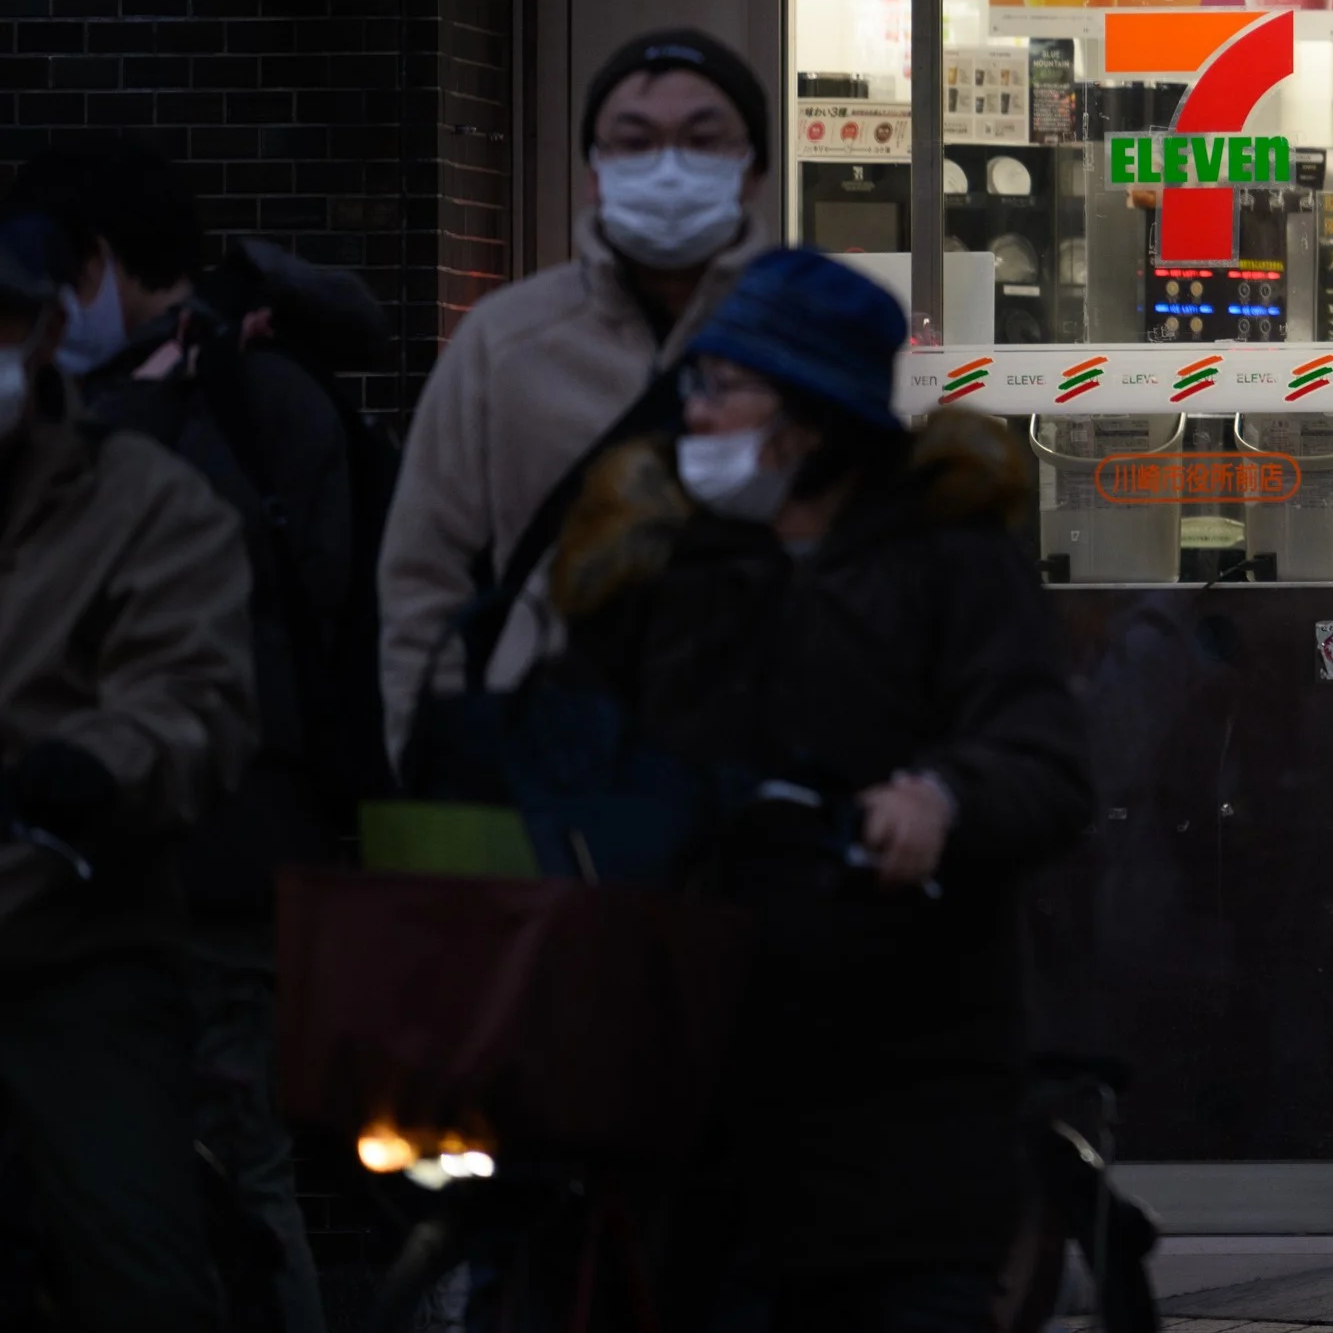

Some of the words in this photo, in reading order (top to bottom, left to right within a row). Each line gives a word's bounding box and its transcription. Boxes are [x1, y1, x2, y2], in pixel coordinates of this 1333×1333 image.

[1113, 463, 1283, 494] 川崎市役所前店
